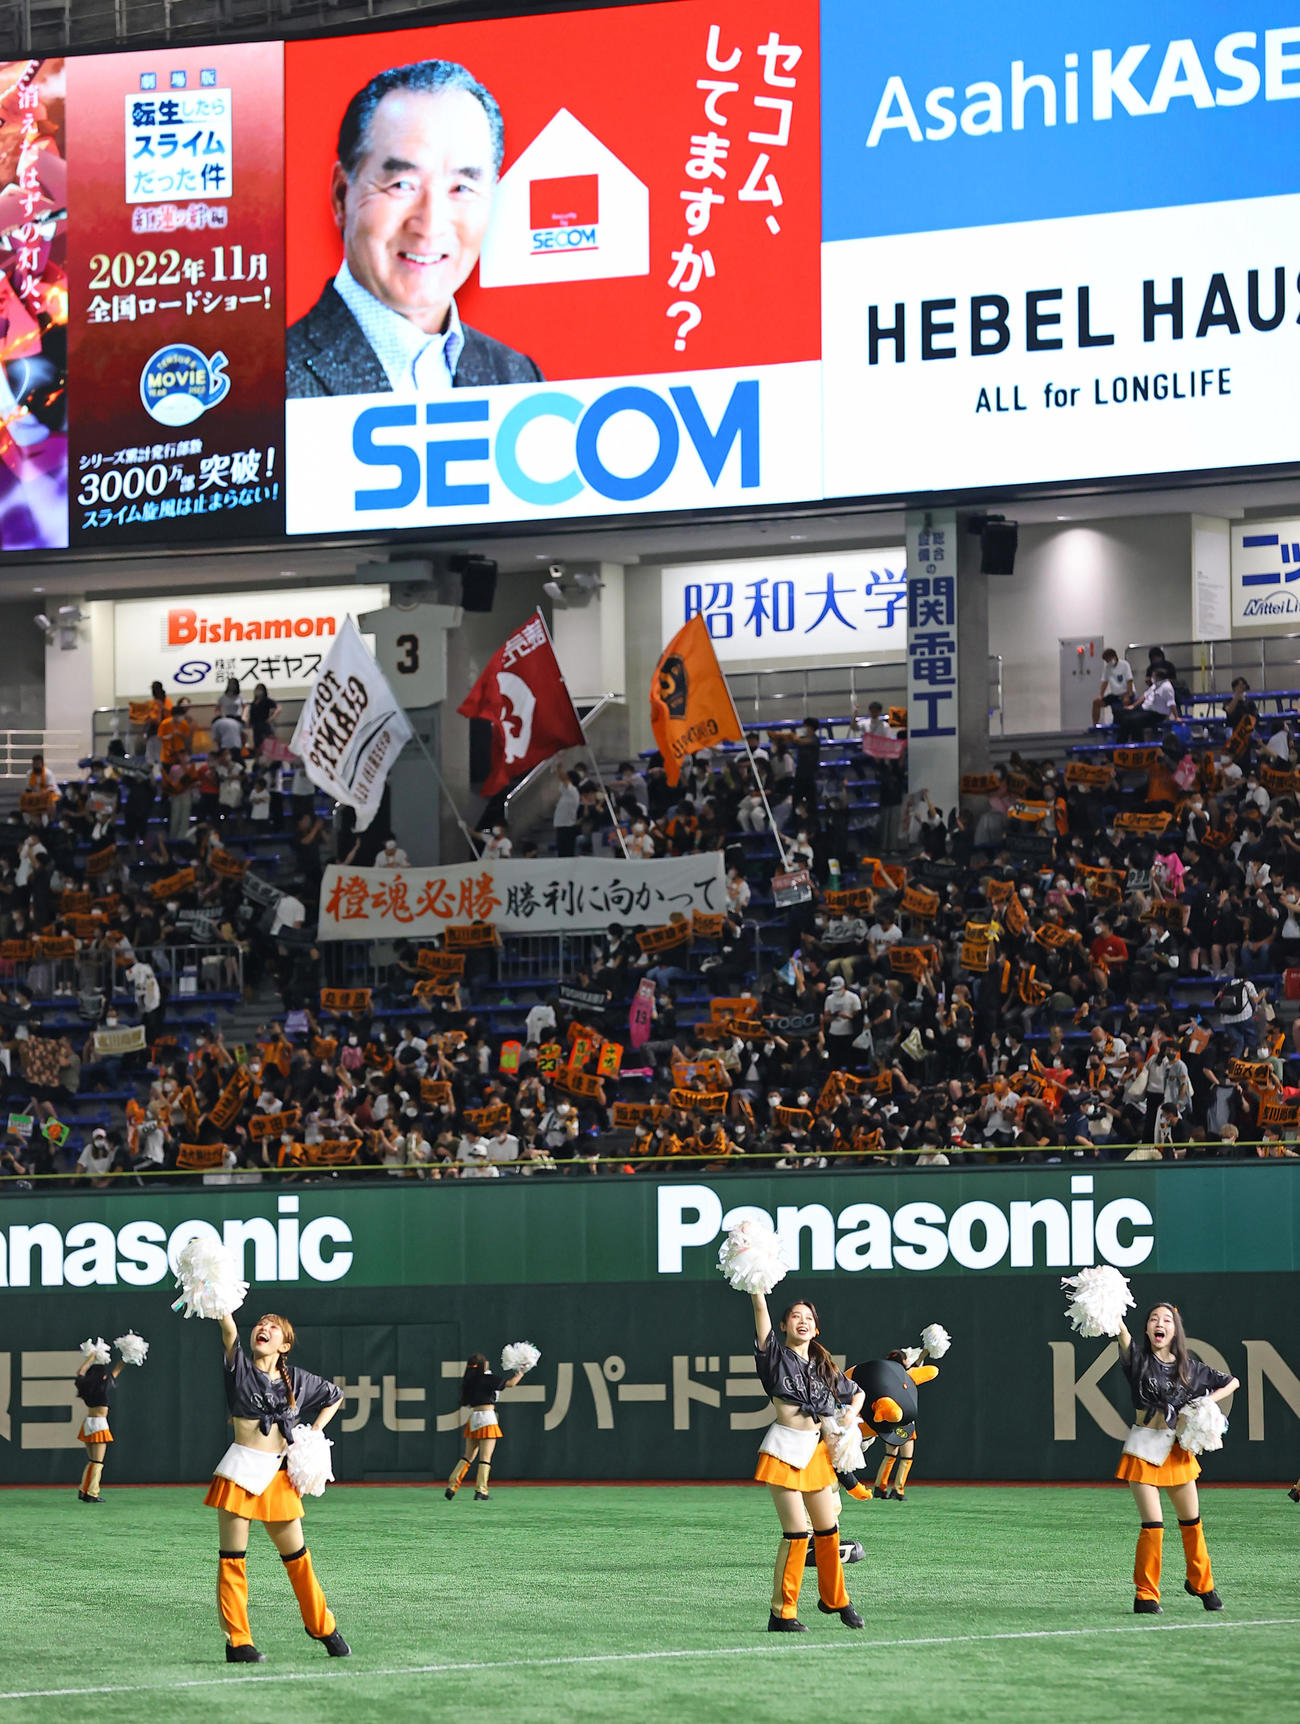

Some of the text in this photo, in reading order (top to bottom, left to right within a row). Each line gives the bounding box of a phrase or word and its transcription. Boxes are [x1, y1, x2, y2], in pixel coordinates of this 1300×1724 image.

[132, 130, 226, 159] スライム
[738, 32, 803, 235] セコム、
[133, 163, 226, 194] だった件
[666, 24, 742, 352] してますか？
[533, 227, 596, 250] SECOM
[89, 245, 268, 290] 2022年11月
[87, 286, 272, 324] 全国ロードショー！
[868, 266, 1300, 365] HEBEL HAU
[147, 369, 207, 389] MOVIE
[975, 368, 1231, 413] ALL for LONGLIFE
[353, 380, 760, 511] SECOM
[685, 567, 907, 639] 昭和大学
[168, 609, 336, 646] Bishamon
[396, 634, 419, 674] 3
[908, 575, 956, 738] 関電工
[326, 872, 502, 923] 橙魂必勝
[505, 876, 718, 918] 勝利に向かって
